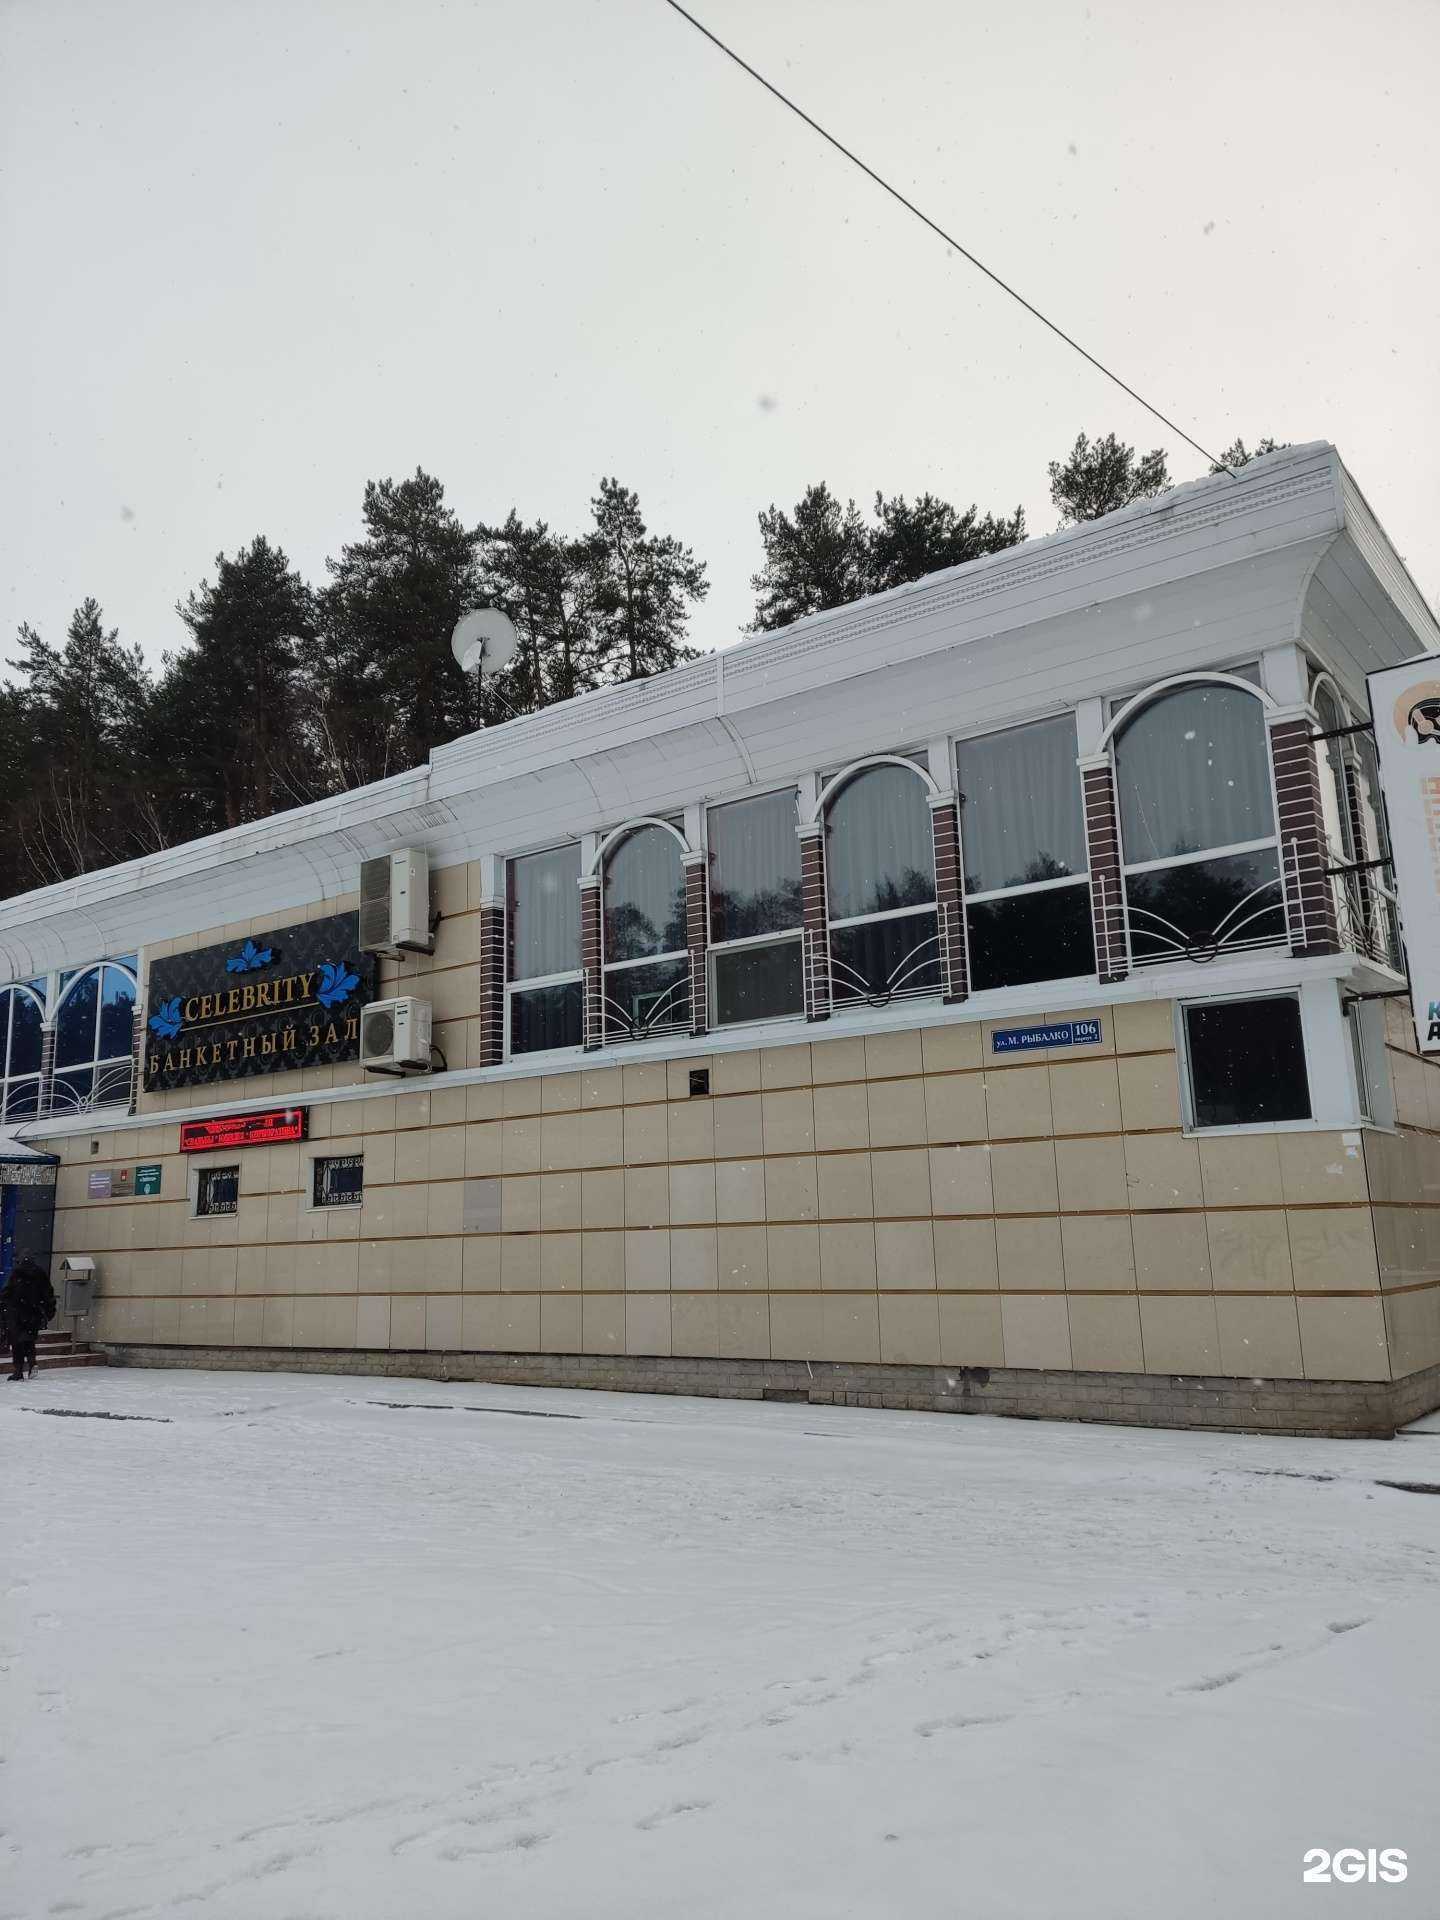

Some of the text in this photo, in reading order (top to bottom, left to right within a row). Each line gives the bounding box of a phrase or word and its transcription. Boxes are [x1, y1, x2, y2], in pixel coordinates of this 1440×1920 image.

[185, 973, 315, 1022] CELEBRITY
[1008, 1036, 1019, 1045] М.
[1022, 1030, 1069, 1044] РЫБАЛКО
[1075, 1023, 1096, 1035] 106
[150, 1018, 360, 1074] БАНКЕТНЫЙ ЗАЛ
